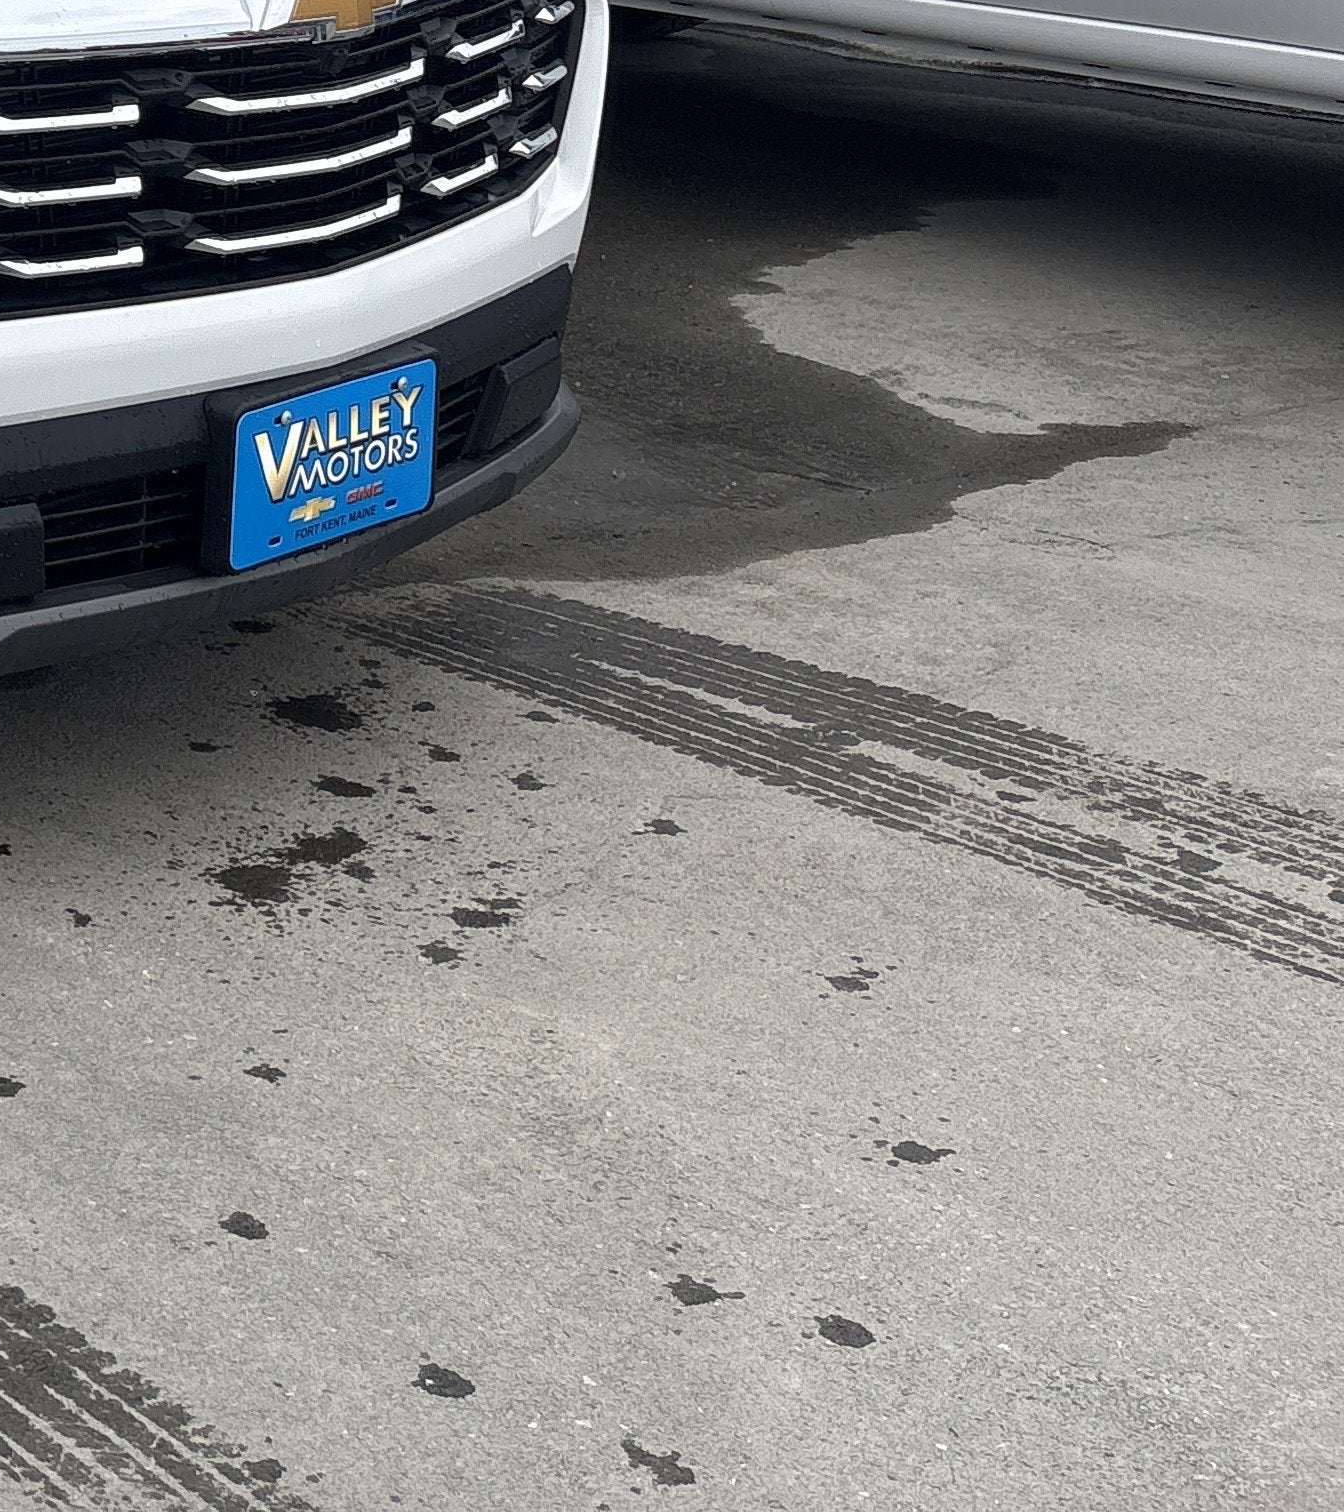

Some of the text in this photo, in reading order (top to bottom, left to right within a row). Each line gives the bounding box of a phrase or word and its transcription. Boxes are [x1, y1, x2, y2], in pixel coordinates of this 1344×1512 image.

[252, 384, 424, 503] VALLEY
[286, 426, 420, 497] MOTORS
[345, 480, 385, 505] GMC
[294, 522, 320, 541] FORT
[348, 505, 378, 526] MAINE
